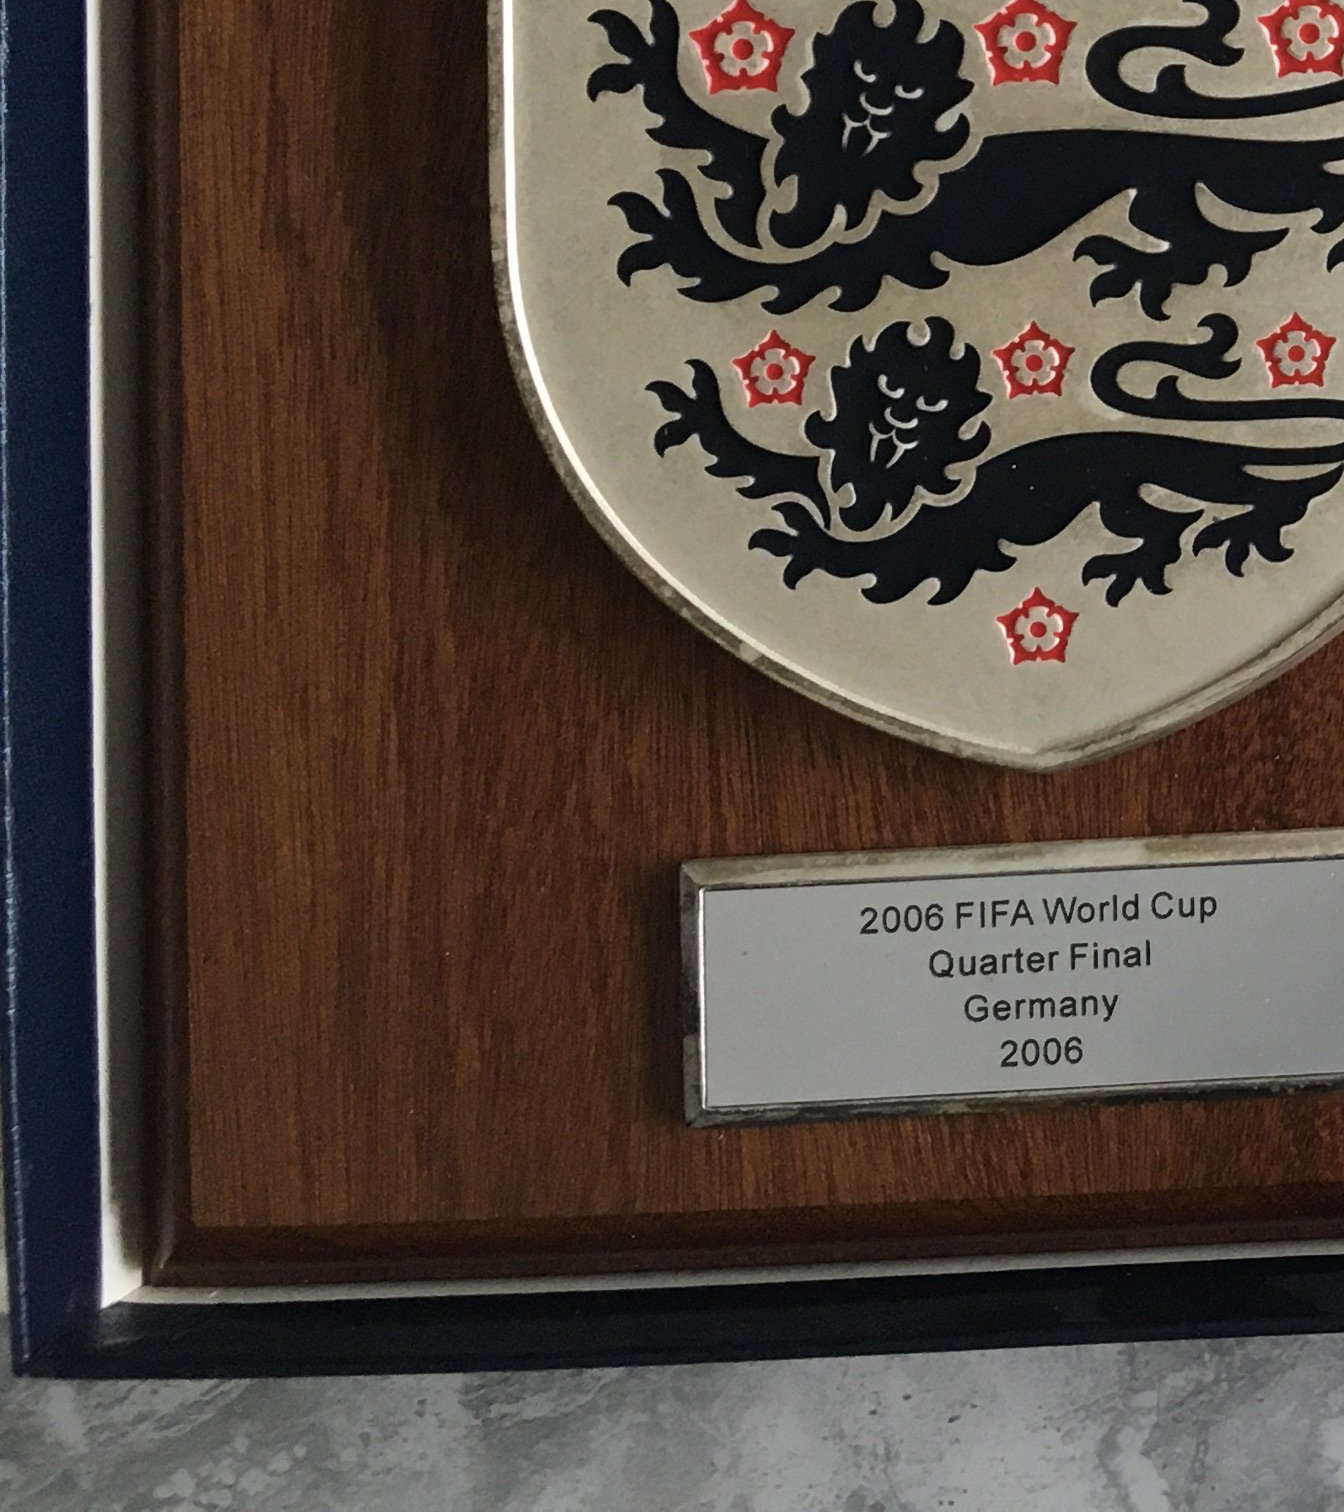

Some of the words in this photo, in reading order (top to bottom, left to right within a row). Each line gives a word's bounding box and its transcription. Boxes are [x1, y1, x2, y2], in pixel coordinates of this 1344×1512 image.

[859, 903, 944, 935] 2006
[955, 899, 1035, 930] FIFA
[1042, 892, 1140, 925] World
[1150, 891, 1218, 924] Cup
[928, 947, 1060, 979] Quarter
[1070, 939, 1151, 971] Final
[964, 994, 1119, 1023] Germany
[1000, 1036, 1083, 1068] 2006
